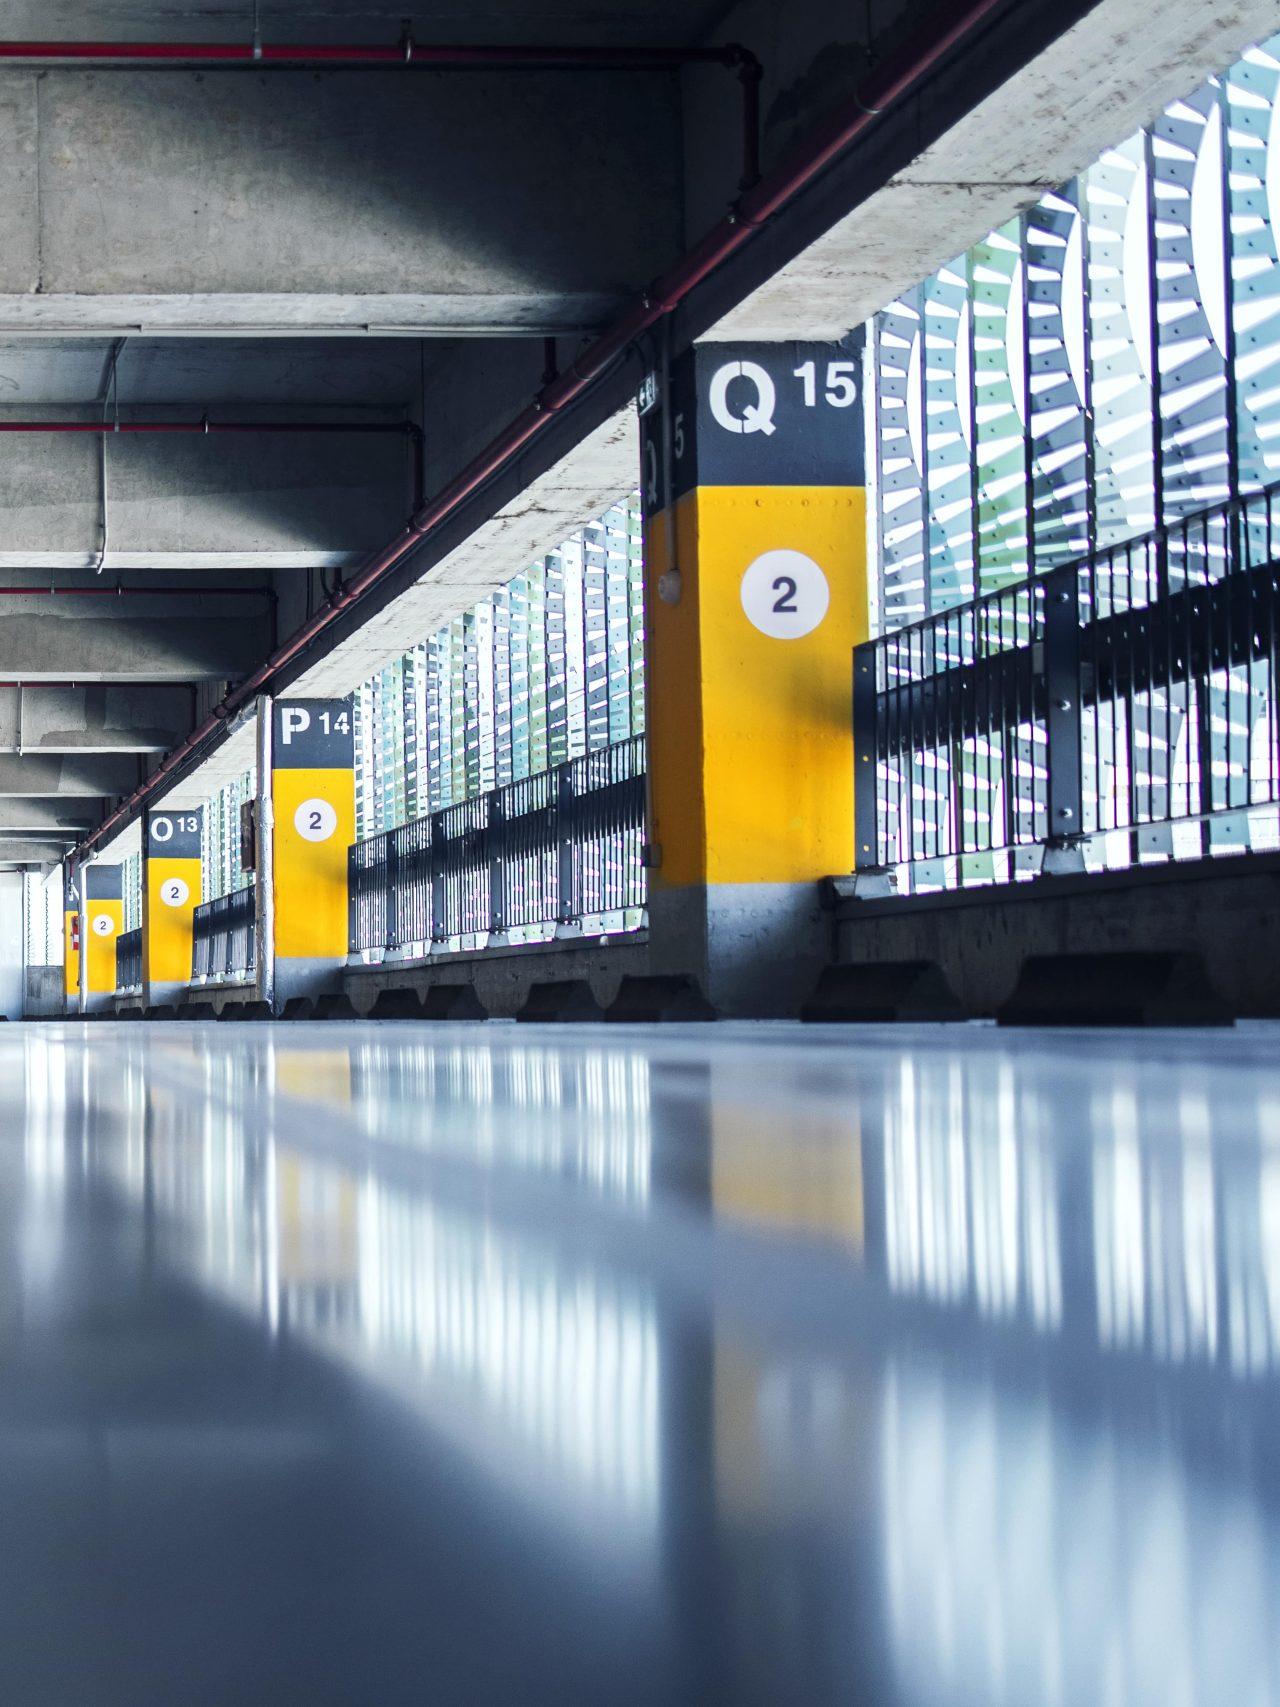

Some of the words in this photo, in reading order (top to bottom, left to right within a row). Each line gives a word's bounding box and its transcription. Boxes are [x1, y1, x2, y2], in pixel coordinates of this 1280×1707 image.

[709, 360, 776, 436] Q
[793, 361, 857, 408] 15
[772, 576, 798, 613] 2
[281, 707, 311, 745] P
[318, 711, 350, 735] 14
[150, 817, 174, 842] O
[177, 817, 198, 833] 13
[308, 812, 322, 830] 2
[170, 887, 180, 899] 2
[100, 920, 107, 931] 2
